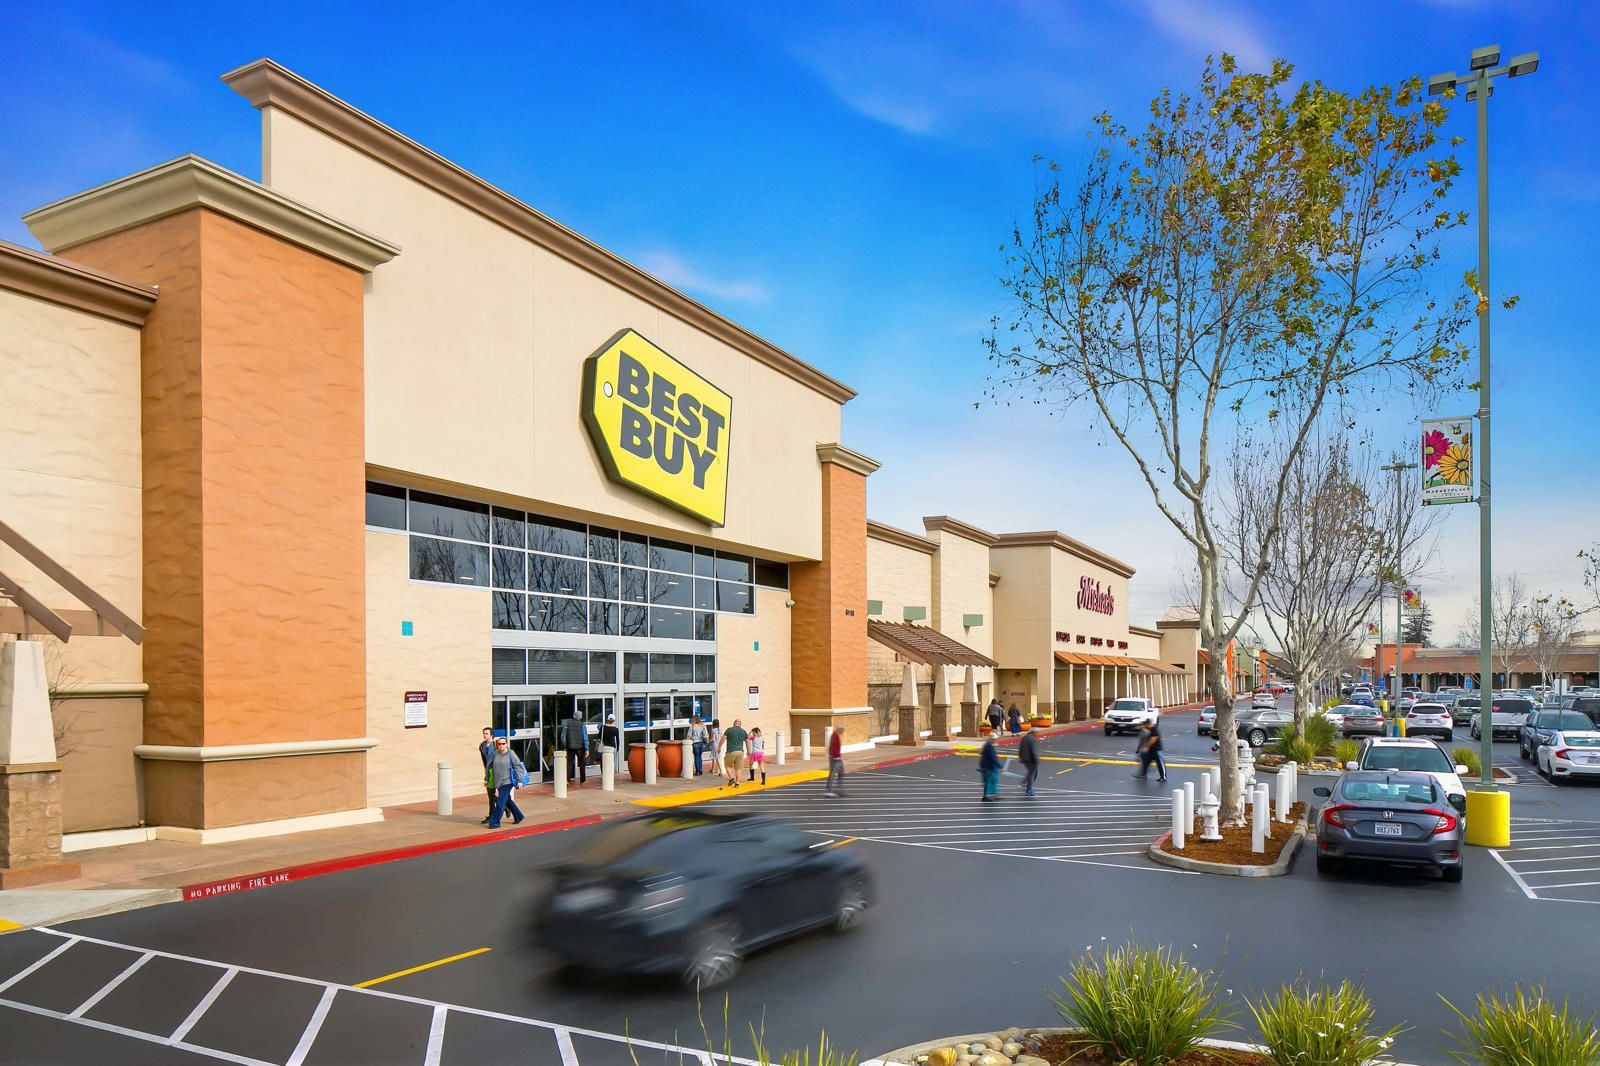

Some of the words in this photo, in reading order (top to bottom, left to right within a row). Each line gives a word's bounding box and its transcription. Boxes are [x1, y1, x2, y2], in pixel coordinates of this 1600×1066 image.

[617, 350, 725, 453] BEST
[620, 402, 717, 490] BUY
[1077, 575, 1114, 616] Michaels
[190, 889, 202, 898] NO
[205, 882, 241, 895] PARKING
[249, 877, 267, 888] FIRE
[270, 873, 289, 884] LANE
